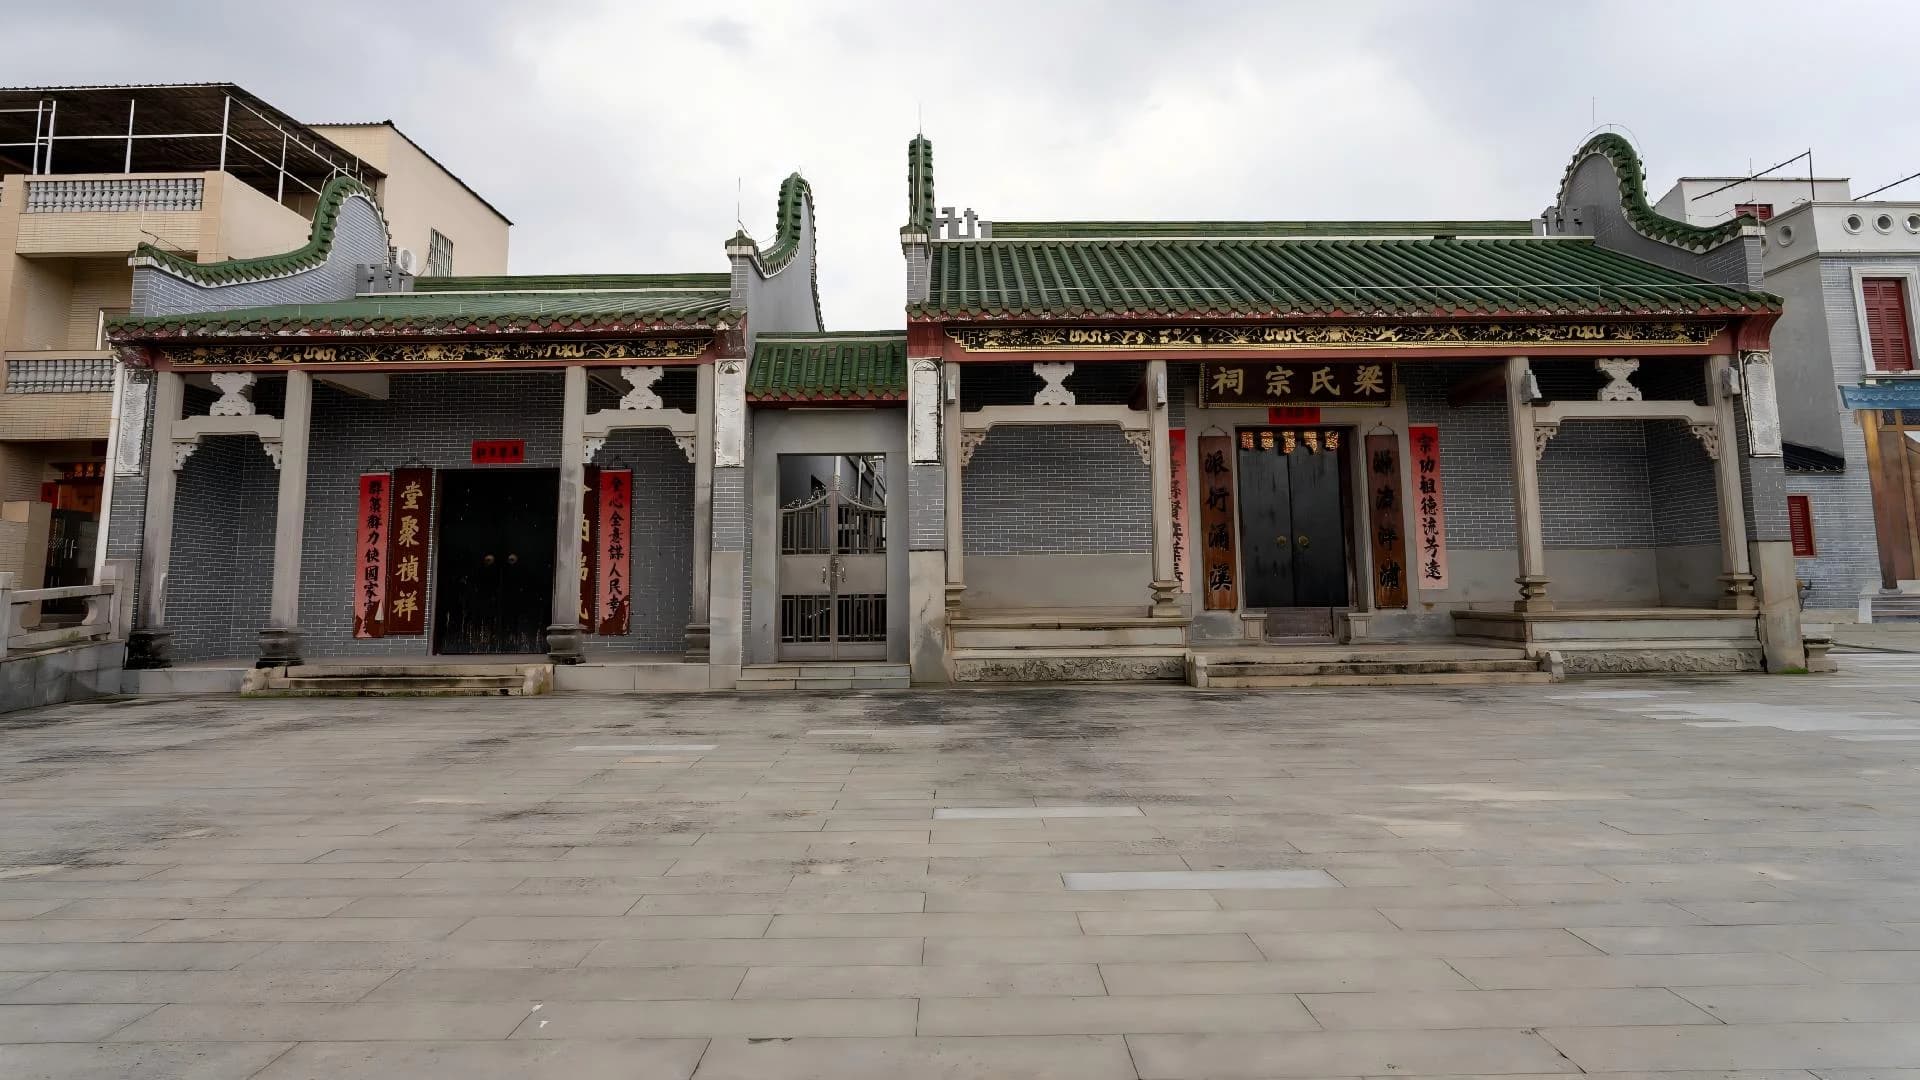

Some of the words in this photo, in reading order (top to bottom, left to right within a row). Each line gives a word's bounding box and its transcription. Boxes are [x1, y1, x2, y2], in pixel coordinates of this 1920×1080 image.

[1210, 364, 1386, 397] 梁氏宗祠
[392, 480, 424, 622] 堂聚禎祥
